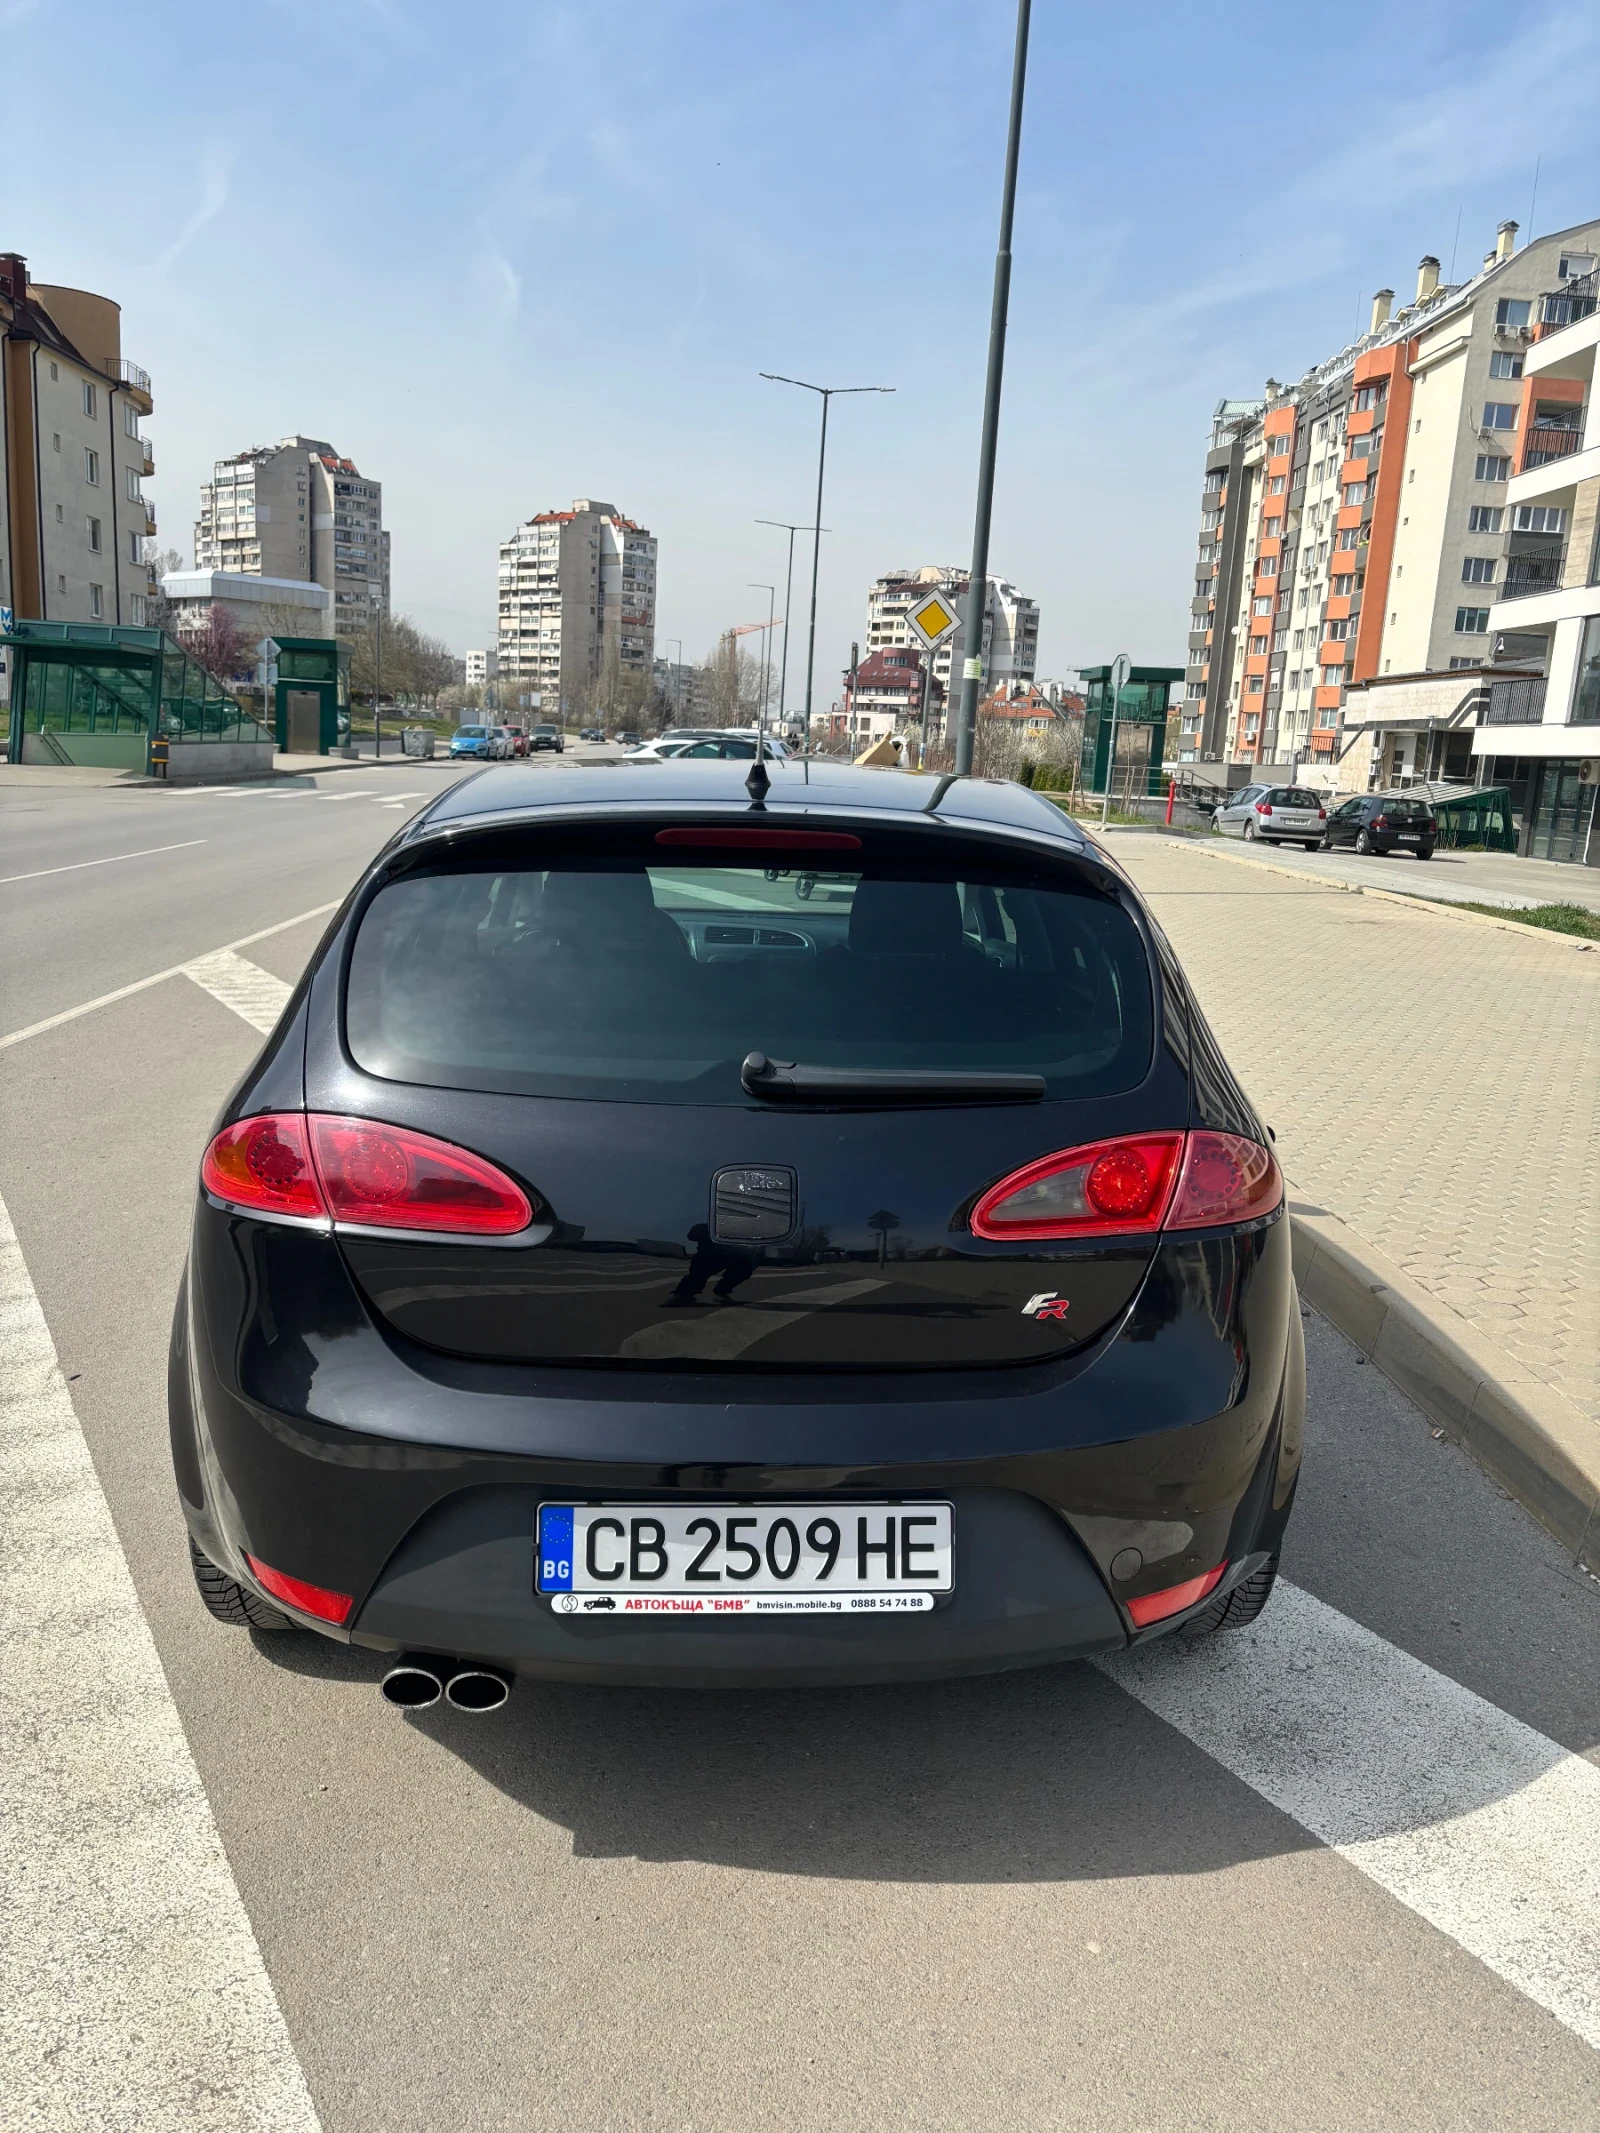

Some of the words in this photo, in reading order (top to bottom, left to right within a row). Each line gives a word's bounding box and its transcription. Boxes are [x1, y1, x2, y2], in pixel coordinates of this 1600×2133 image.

[1021, 1291, 1070, 1320] FR
[585, 1516, 669, 1582] CB
[684, 1516, 842, 1581] 2509
[856, 1515, 940, 1580] HE
[542, 1559, 570, 1579] BG
[624, 1599, 704, 1612] АВТОКЪЩА
[756, 1600, 842, 1610] bmvisin.mobile.bg
[850, 1598, 877, 1608] 0888
[879, 1598, 892, 1608] 54
[895, 1598, 907, 1608] 74
[910, 1598, 923, 1607] 88
